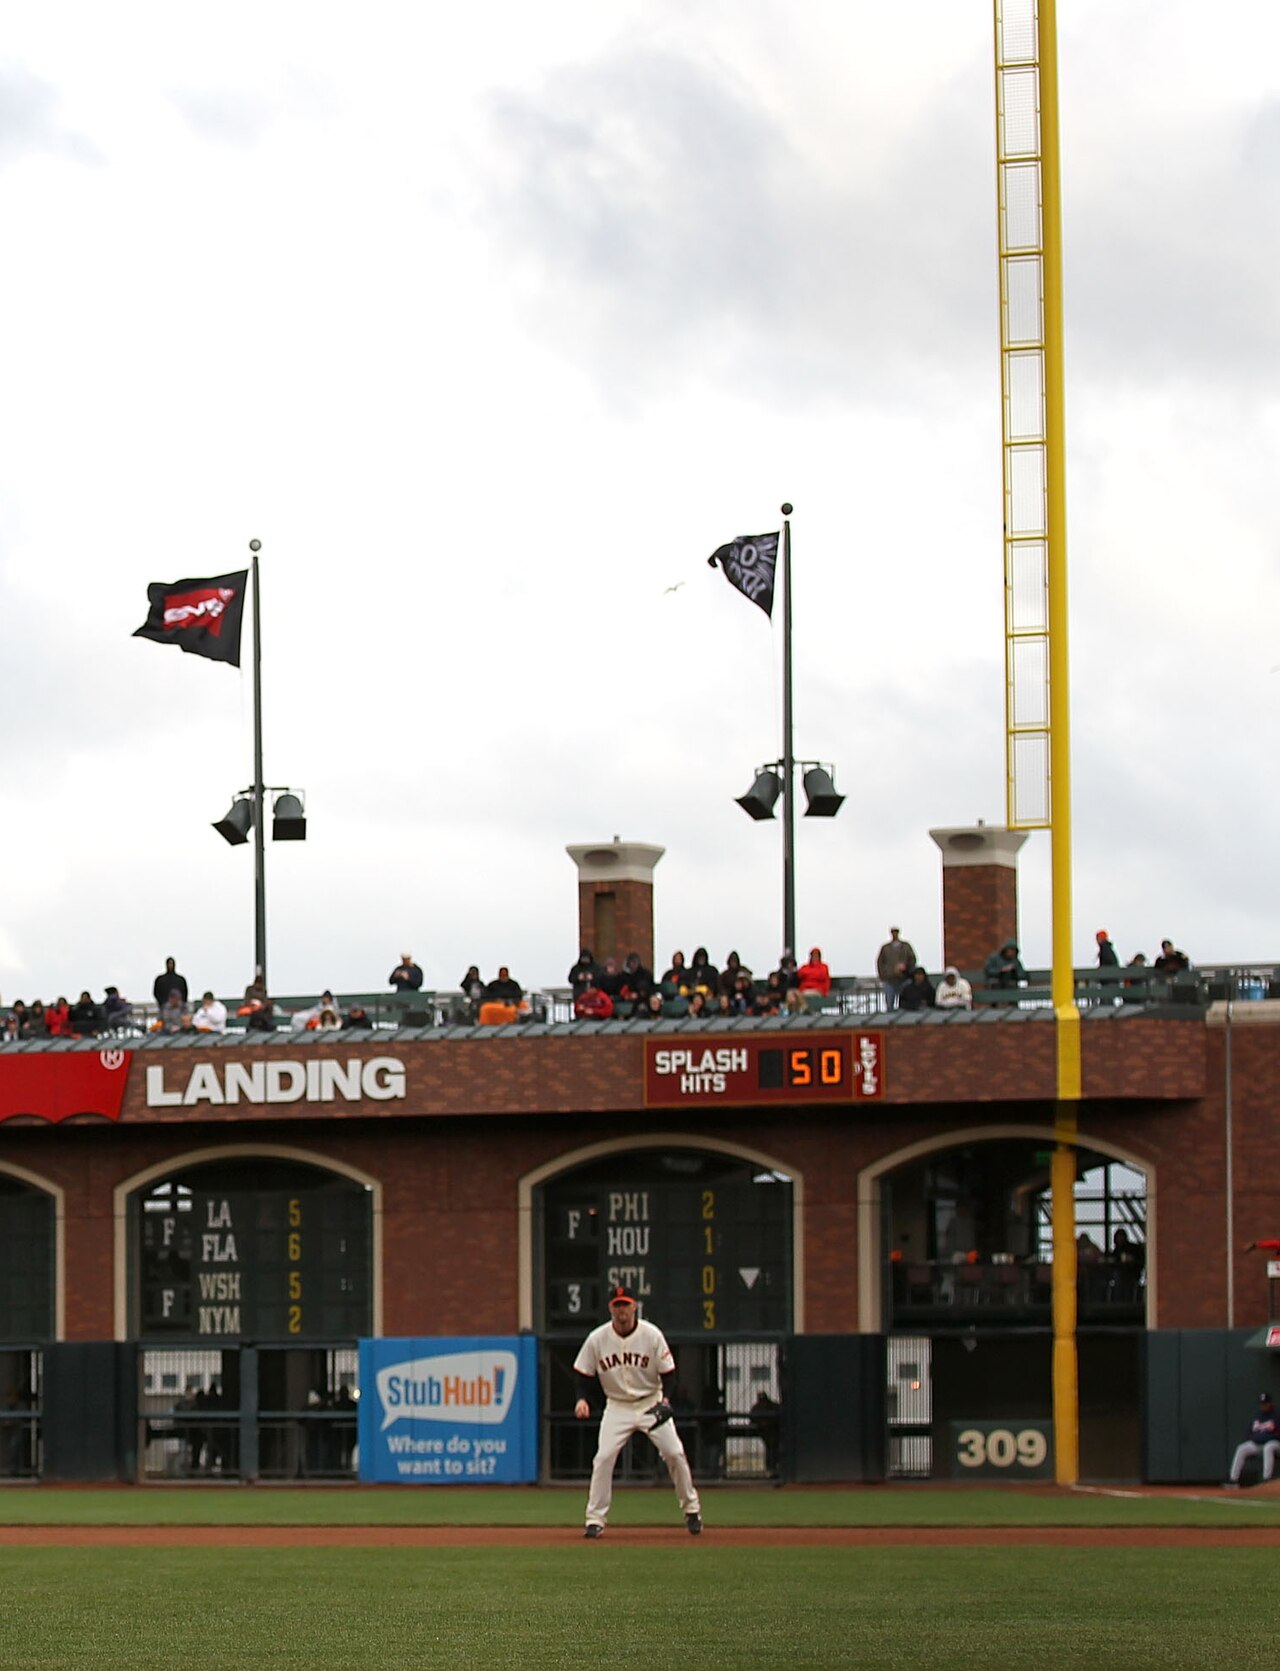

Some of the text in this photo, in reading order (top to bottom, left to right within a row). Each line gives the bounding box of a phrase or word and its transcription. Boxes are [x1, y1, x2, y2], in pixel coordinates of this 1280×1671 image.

[655, 1048, 748, 1074] SPLASH
[791, 1050, 842, 1085] 50
[147, 1057, 407, 1107] LANDING
[680, 1074, 726, 1094] HITS
[207, 1200, 301, 1228] LA 5
[703, 1191, 714, 1219] 2
[163, 1218, 175, 1245] F
[568, 1211, 580, 1239] F
[202, 1233, 301, 1262] FLA 6
[608, 1227, 713, 1256] HOU 1
[199, 1272, 301, 1300] WSH 5
[568, 1284, 581, 1313] 3
[162, 1290, 174, 1317] F
[703, 1301, 715, 1329] 3
[199, 1305, 301, 1334] NYM 2
[387, 1365, 505, 1407] StubHub!
[387, 1435, 507, 1459] Where do you
[957, 1429, 1048, 1468] 309
[397, 1456, 497, 1475] want to sit?
